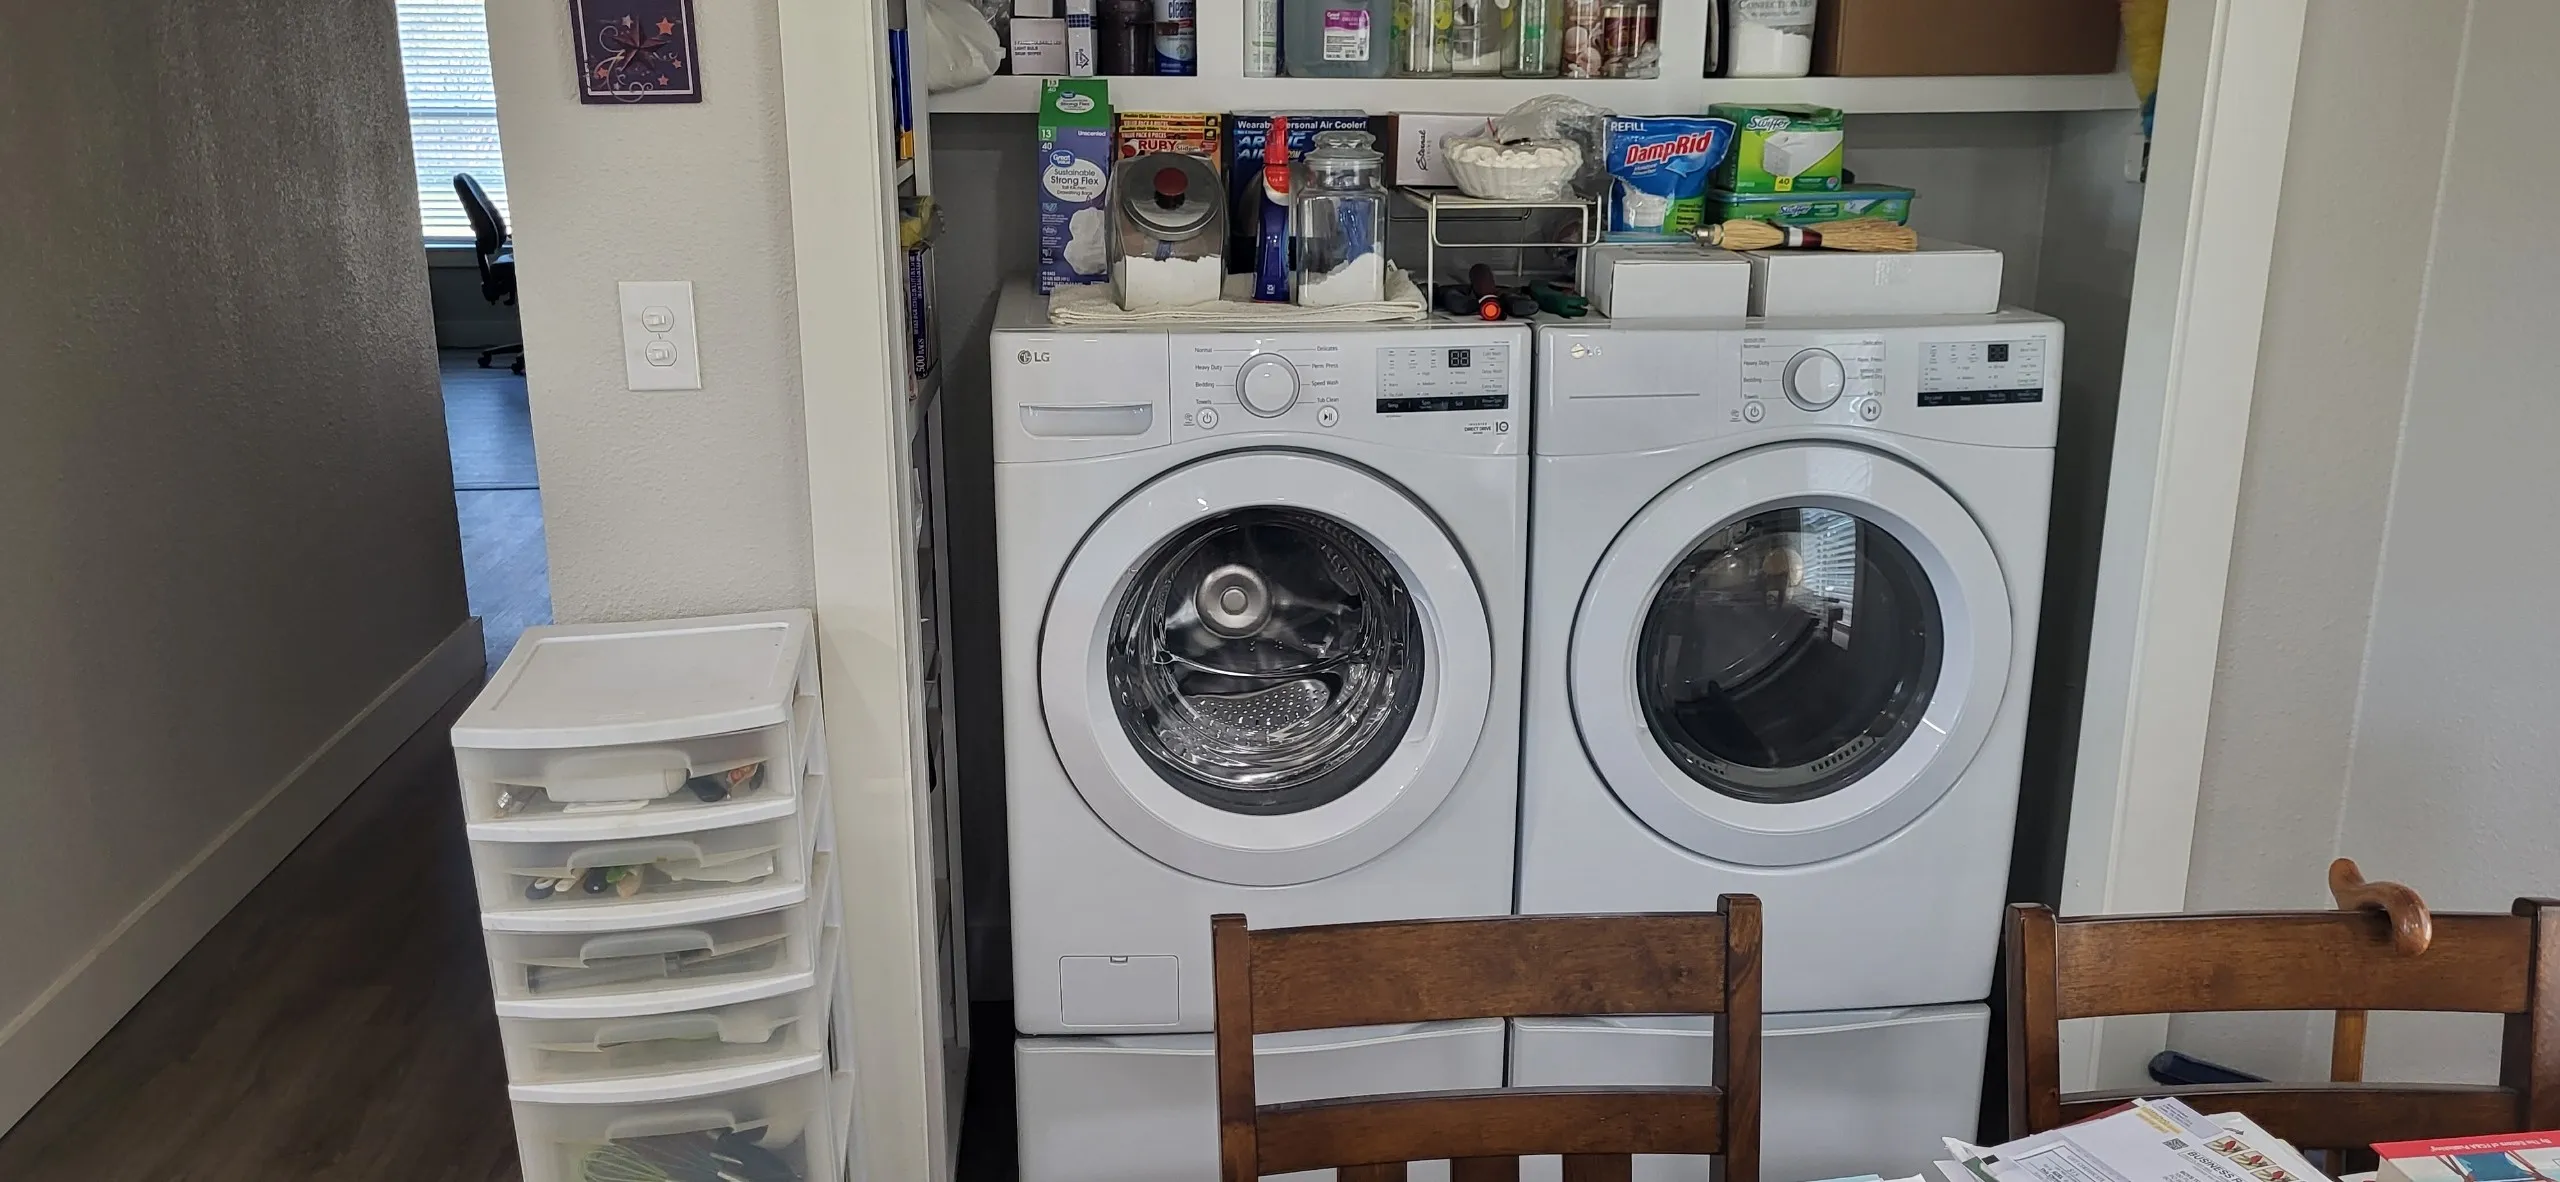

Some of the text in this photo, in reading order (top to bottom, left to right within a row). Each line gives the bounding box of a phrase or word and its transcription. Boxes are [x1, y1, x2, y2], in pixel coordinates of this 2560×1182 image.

[1238, 121, 1366, 129] Wearab ersonal Air Cooler!
[1611, 122, 1648, 132] REFILL
[1749, 115, 1789, 130] Swiffer
[1042, 129, 1052, 138] 13
[1042, 142, 1052, 150] 40
[1139, 140, 1178, 151] RUBY
[1416, 130, 1428, 171] Eternal
[1625, 130, 1715, 166] DampRid
[1054, 168, 1096, 176] Sustainable
[1051, 176, 1099, 187] Strong Flex
[1780, 204, 1812, 216] Swiffer
[916, 356, 926, 372] 500
[1195, 364, 1222, 372] Heavy Duty
[1195, 381, 1215, 389] Bedding
[1312, 380, 1326, 388] Speed
[2187, 1151, 2235, 1179] BUSINESS
